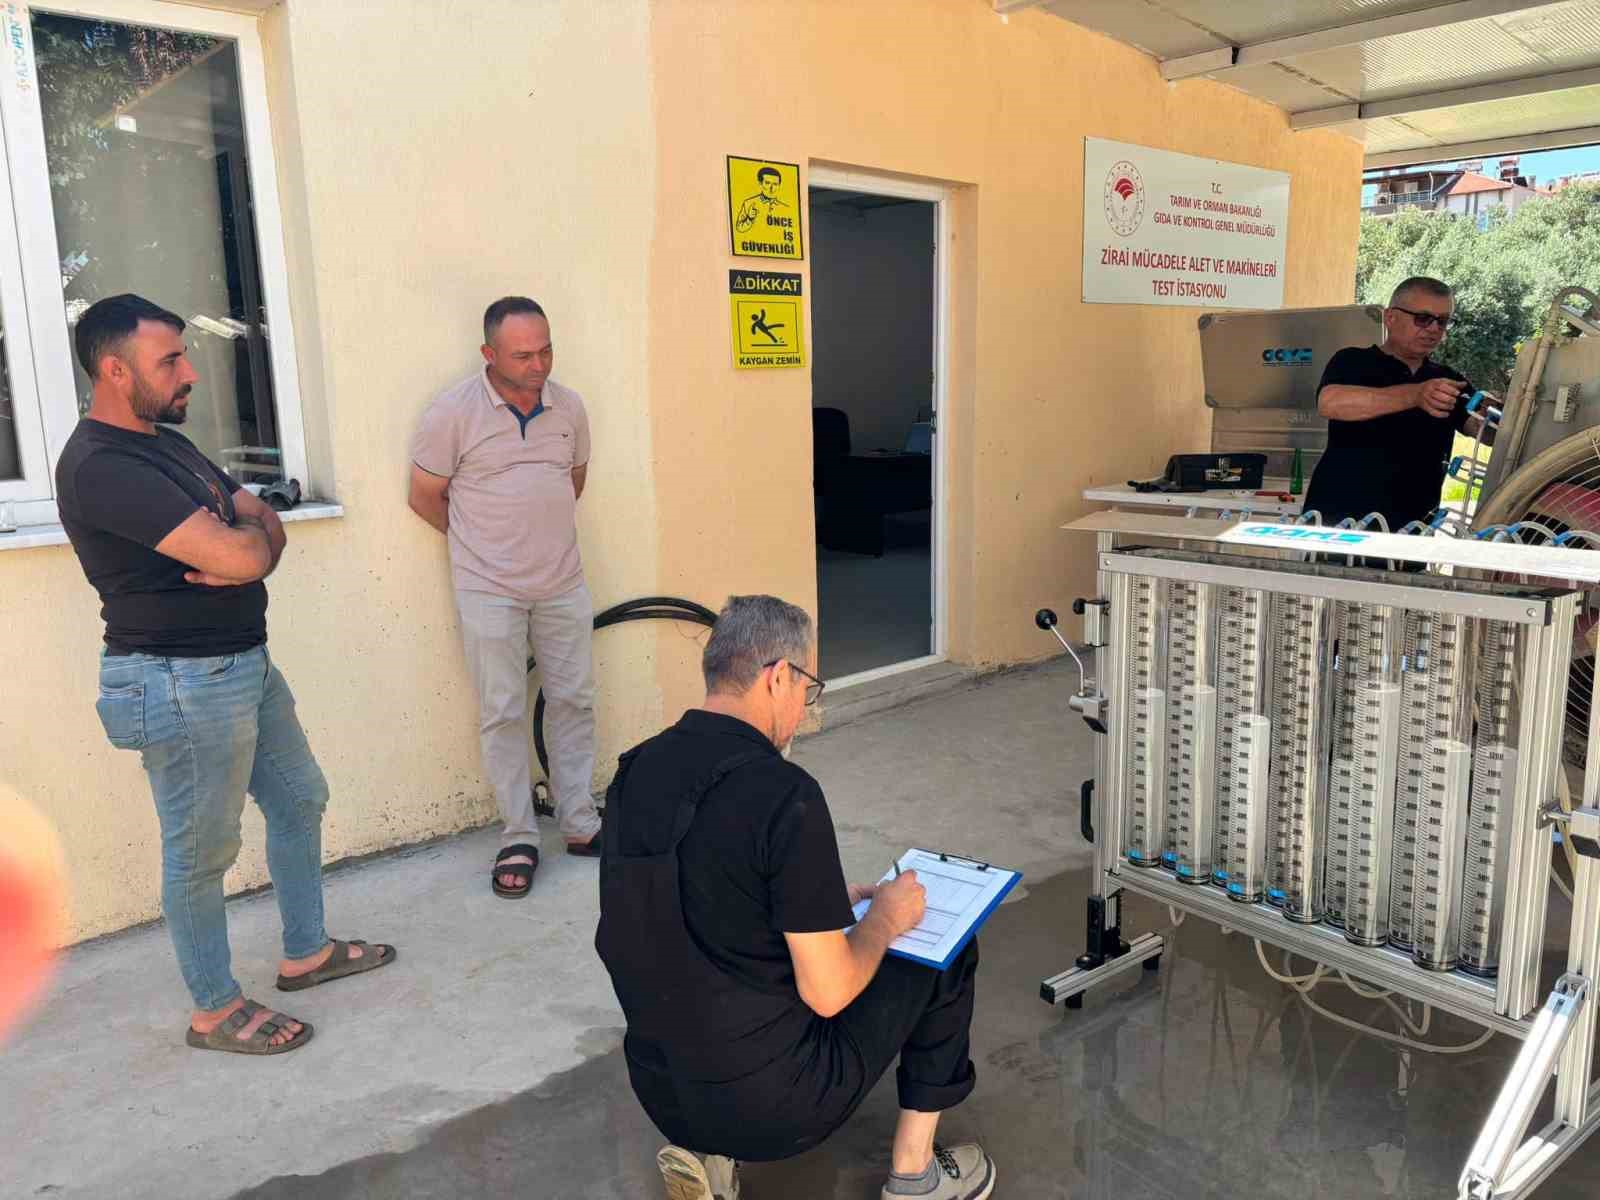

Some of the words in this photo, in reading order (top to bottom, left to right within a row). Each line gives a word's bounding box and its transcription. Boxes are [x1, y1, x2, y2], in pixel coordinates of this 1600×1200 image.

[1211, 182, 1223, 194] T.C.
[1170, 195, 1192, 208] TARIM
[1193, 199, 1202, 210] VE
[1203, 200, 1229, 213] ORMAN
[1229, 204, 1262, 217] BAKANLIĞI
[767, 214, 793, 228] ÖNCE
[1153, 211, 1171, 224] GIDA
[1172, 215, 1182, 226] VE
[1183, 216, 1214, 230] KONTROL
[1215, 221, 1235, 233] GENEL
[741, 240, 795, 255] GÜVENLİĞİ
[1101, 245, 1130, 266] ZİRAİ
[1131, 249, 1187, 271] MÜCADELE
[1188, 255, 1211, 273] ALET
[1212, 259, 1225, 274] VE
[1226, 258, 1277, 278] MAKİNELERİ
[745, 275, 800, 292] DİKKAT
[1152, 280, 1176, 296] TEST
[1176, 278, 1228, 299] İSTASYONU
[739, 356, 774, 366] KAYGAN
[775, 354, 801, 365] ZEMİN
